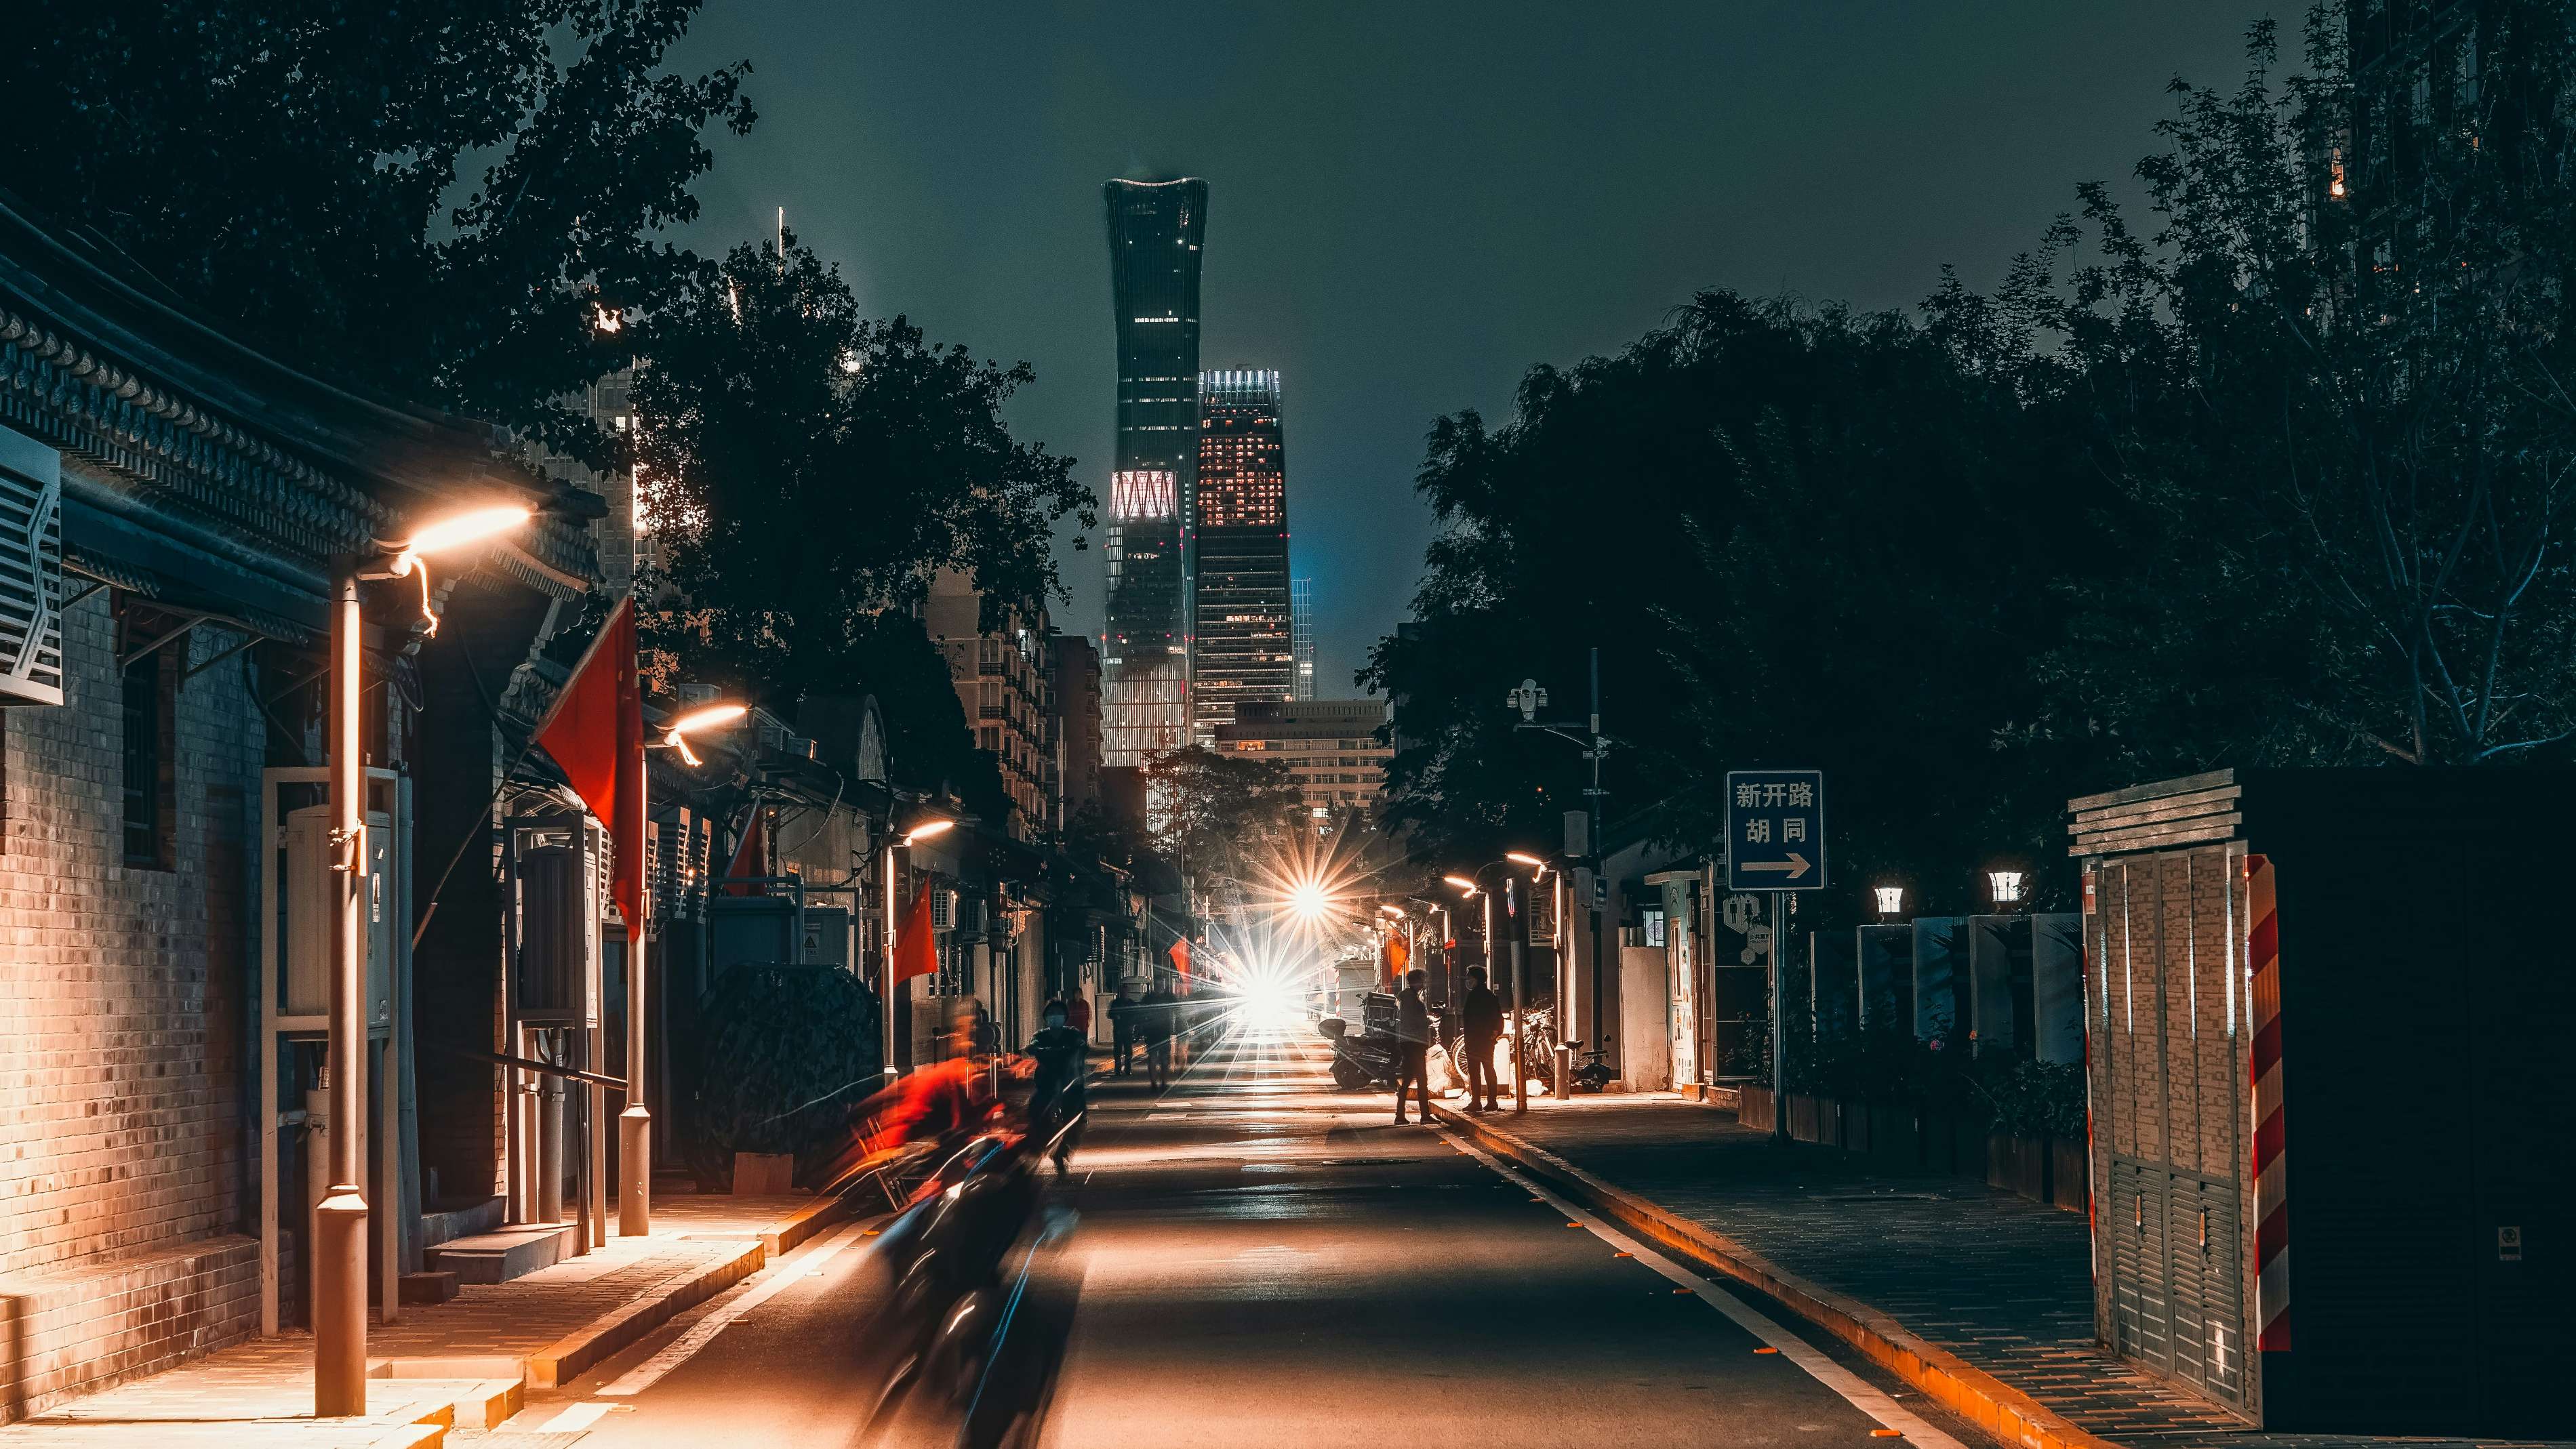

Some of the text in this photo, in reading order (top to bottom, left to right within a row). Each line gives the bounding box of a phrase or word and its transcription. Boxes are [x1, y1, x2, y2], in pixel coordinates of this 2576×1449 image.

[1737, 782, 1813, 807] 新开路
[1746, 818, 1805, 843] 胡同
